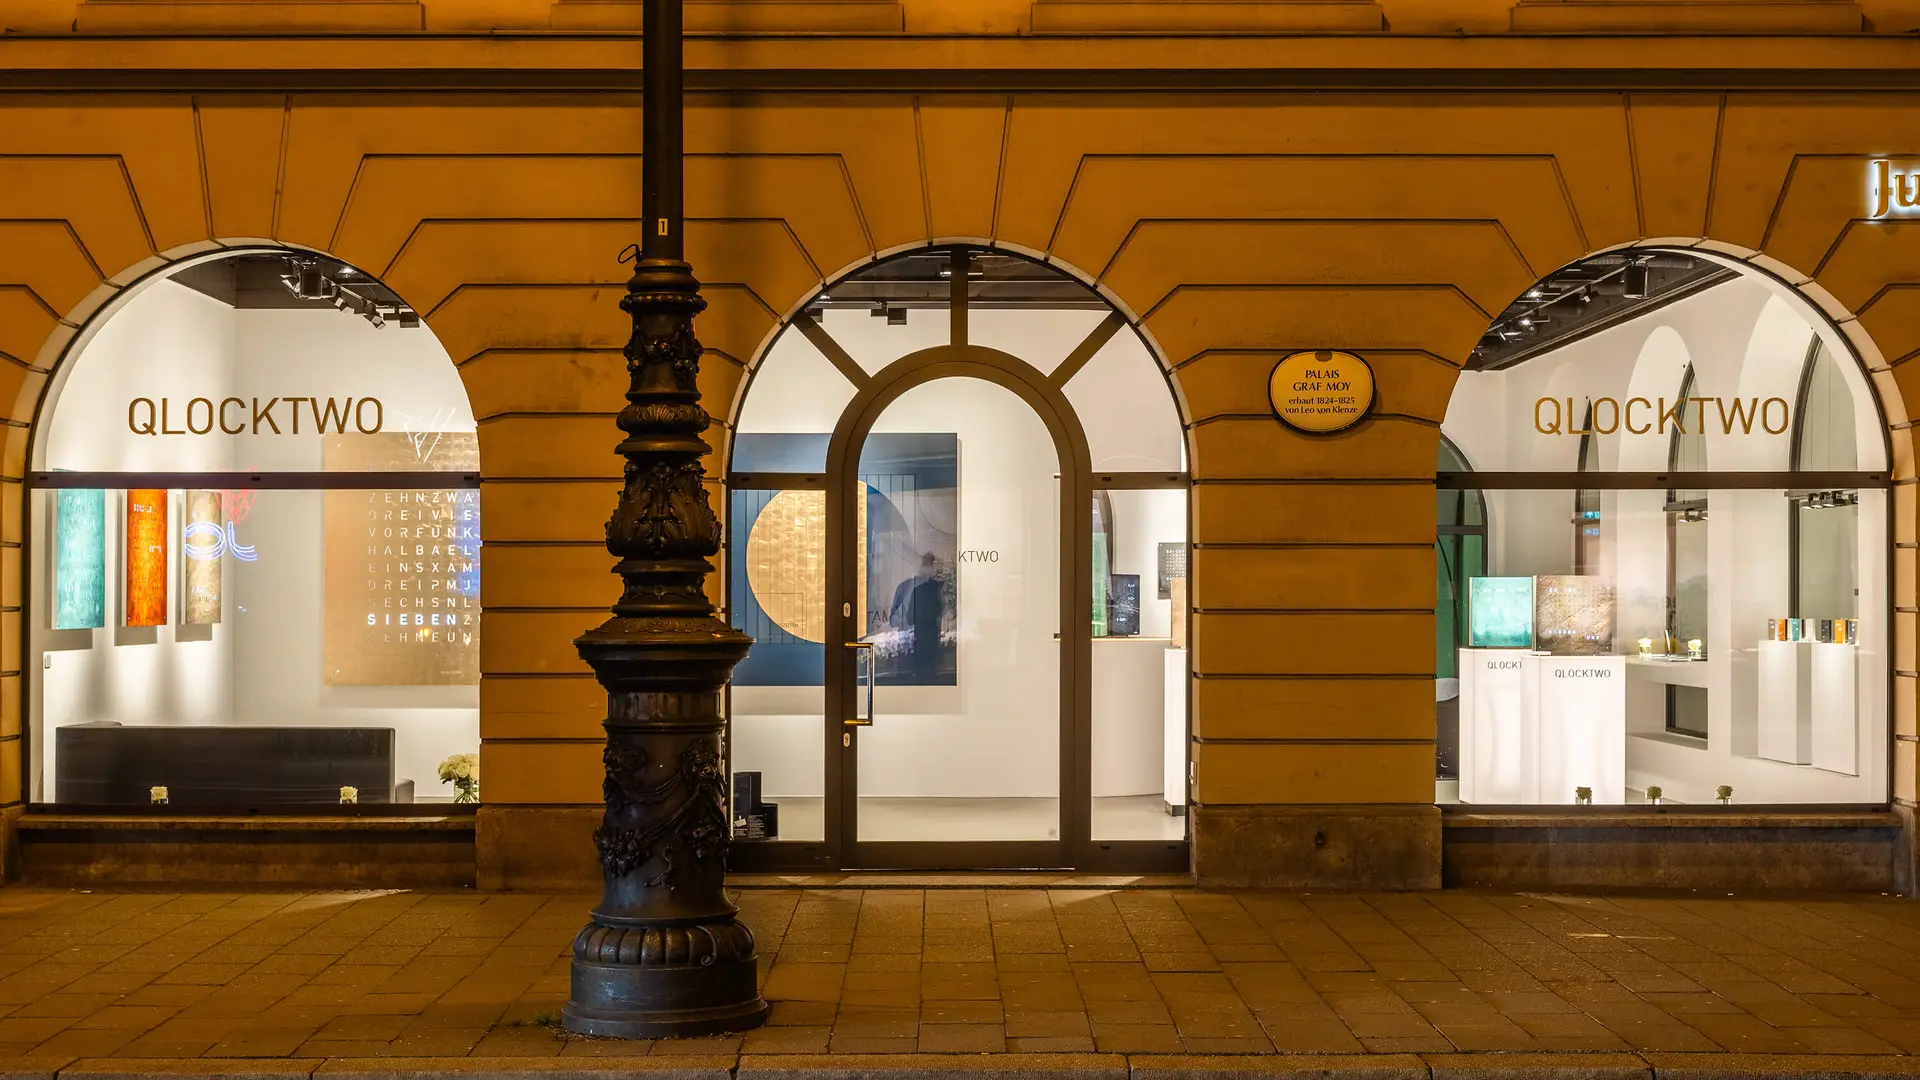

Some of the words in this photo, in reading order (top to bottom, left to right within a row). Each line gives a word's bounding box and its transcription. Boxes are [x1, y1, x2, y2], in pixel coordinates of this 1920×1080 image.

[1872, 160, 1920, 217] Ju
[1305, 369, 1340, 379] PALAIS
[1293, 382, 1322, 391] GRAF
[1326, 381, 1352, 391] MOY
[1288, 396, 1314, 404] erbaut
[1317, 396, 1355, 404] 1824-1825
[1301, 405, 1315, 414] Leo
[1332, 405, 1358, 414] Klenze
[128, 397, 383, 436] QLOCKTWO
[1534, 396, 1789, 436] QLOCKTWO
[958, 550, 999, 562] KTWO
[1554, 669, 1611, 678] QLOCKTWO
